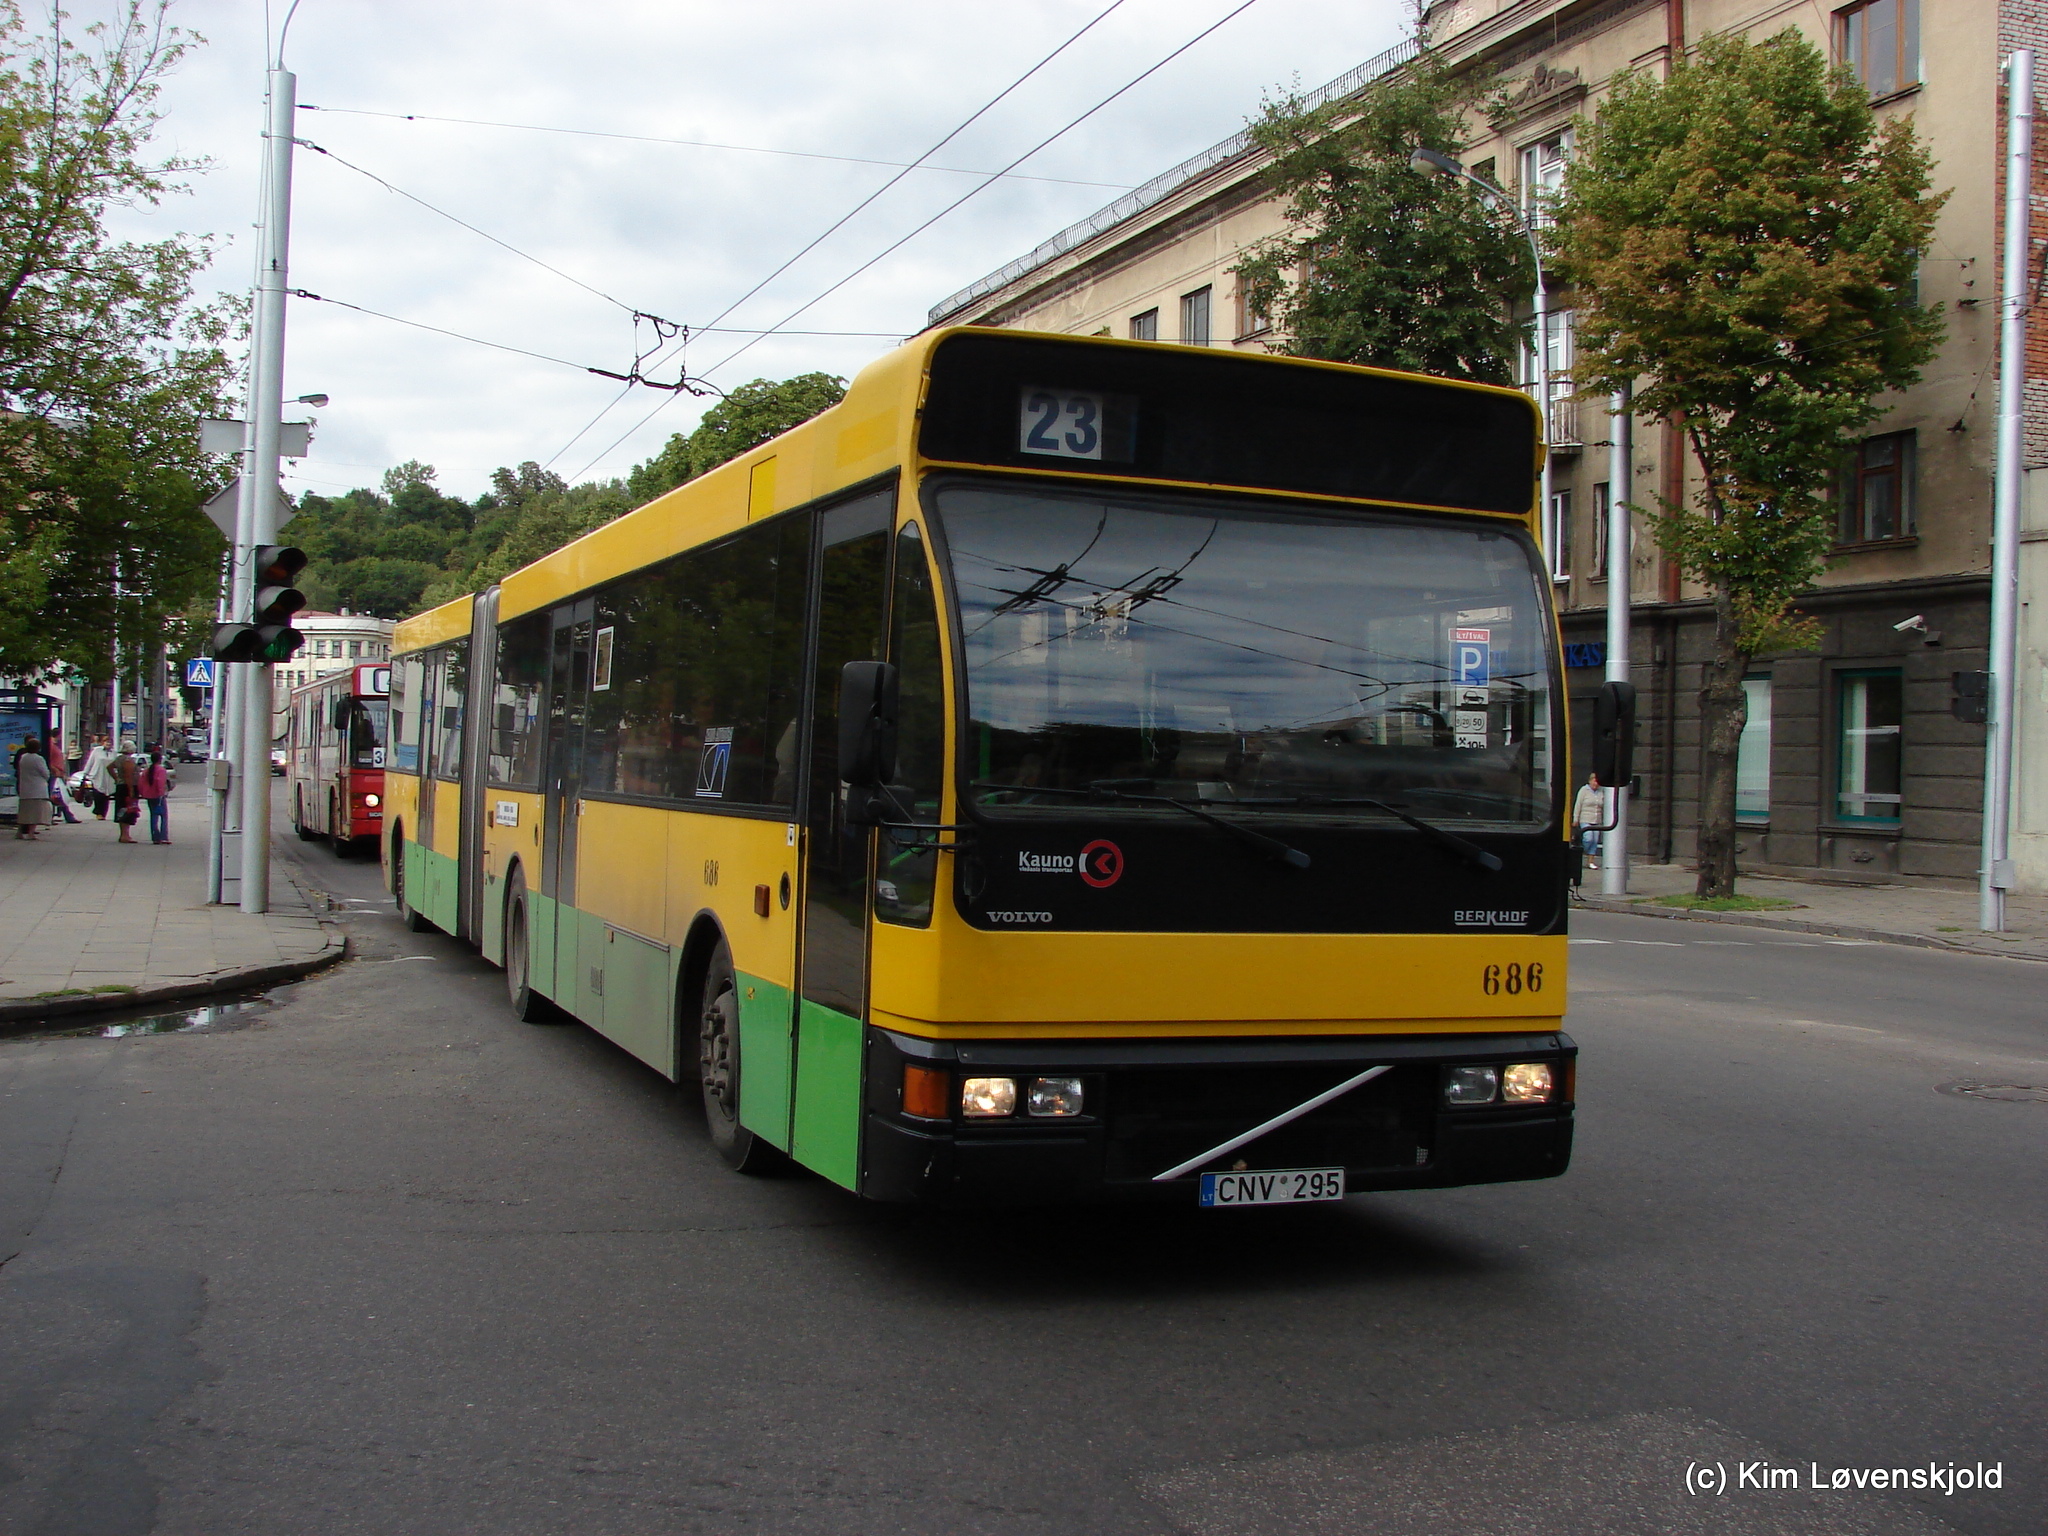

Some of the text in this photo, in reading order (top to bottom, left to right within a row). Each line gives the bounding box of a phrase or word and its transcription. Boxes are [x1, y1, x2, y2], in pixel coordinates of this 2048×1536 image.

[1026, 392, 1098, 454] 23
[1460, 647, 1482, 682] P
[1563, 642, 1602, 668] KAS
[1472, 718, 1482, 727] 50
[703, 859, 719, 887] 686
[1019, 851, 1074, 868] Kauno
[986, 911, 1053, 923] VOLVO
[1454, 910, 1529, 926] BERKHOF
[1483, 962, 1543, 996] 686
[1202, 1172, 1339, 1202] LT CNV 295
